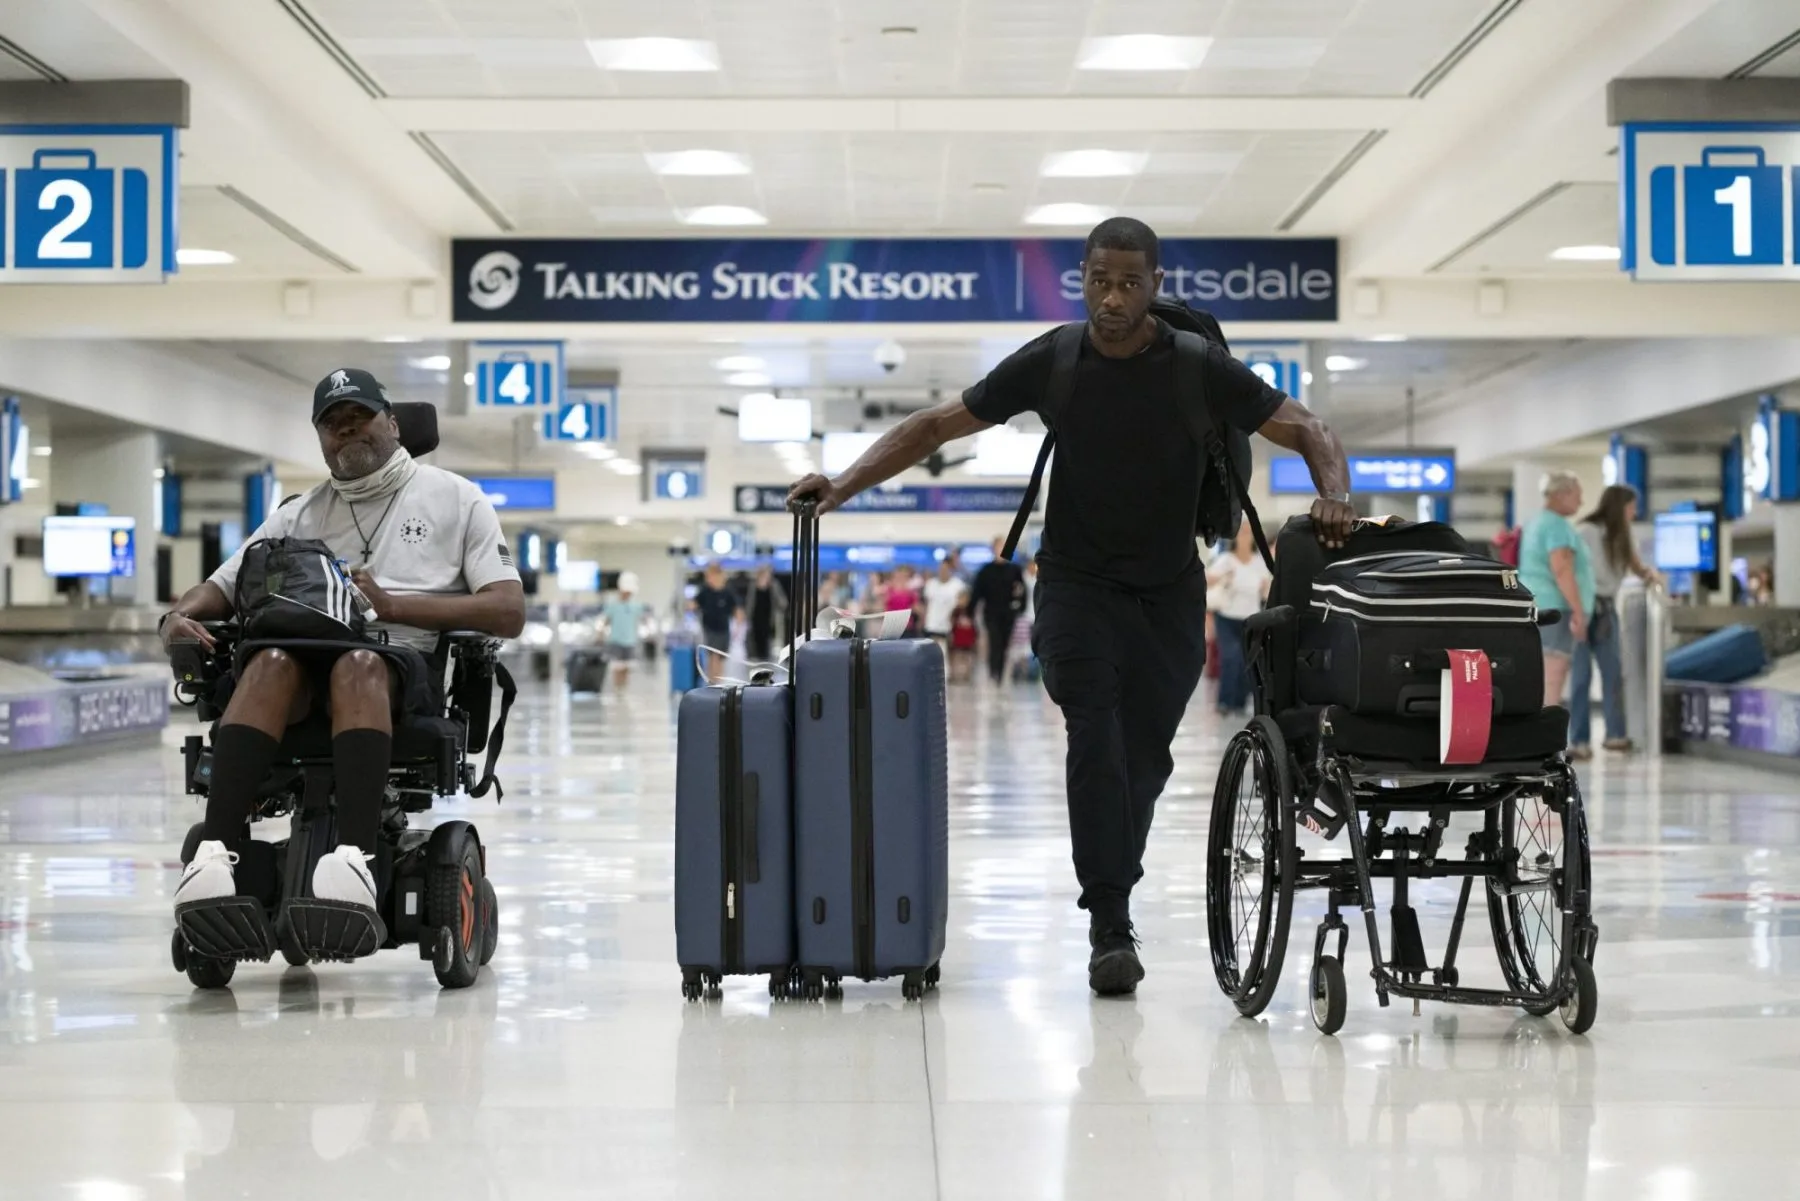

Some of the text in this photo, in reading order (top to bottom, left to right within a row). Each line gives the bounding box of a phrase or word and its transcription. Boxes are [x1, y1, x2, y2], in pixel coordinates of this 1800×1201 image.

[37, 178, 93, 259] 2
[1714, 175, 1752, 257] 1
[533, 261, 980, 300] TALKING STICK RESORT
[1059, 261, 1333, 301] sttsdale
[498, 362, 531, 405] 4
[561, 403, 590, 440] 4
